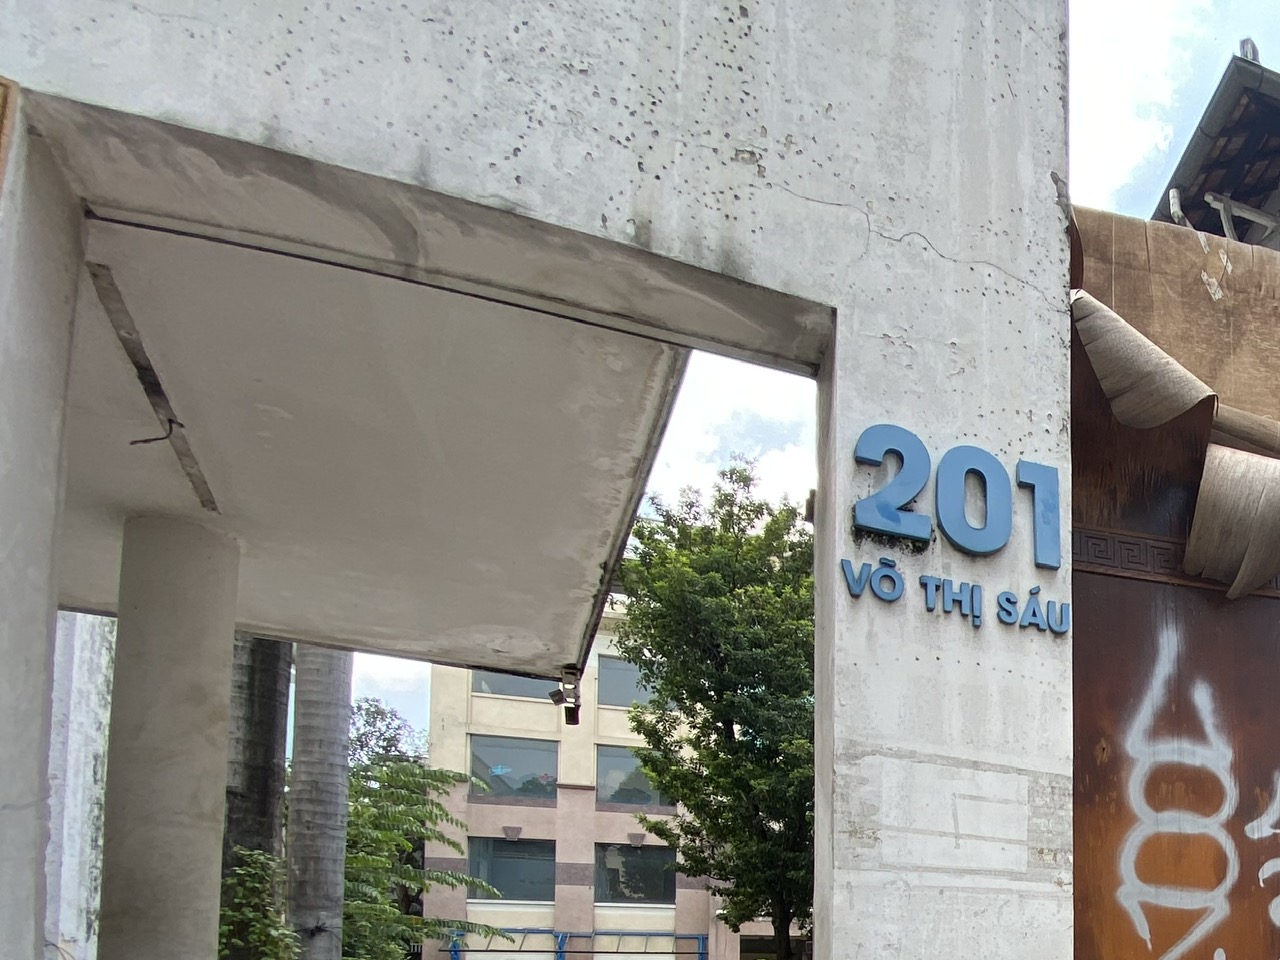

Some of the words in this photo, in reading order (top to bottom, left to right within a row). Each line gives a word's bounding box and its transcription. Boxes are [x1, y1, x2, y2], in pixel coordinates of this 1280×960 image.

[854, 423, 1061, 571] 201
[840, 556, 905, 602] VÕ
[919, 574, 982, 628] THỊ
[997, 585, 1070, 634] SÁU
